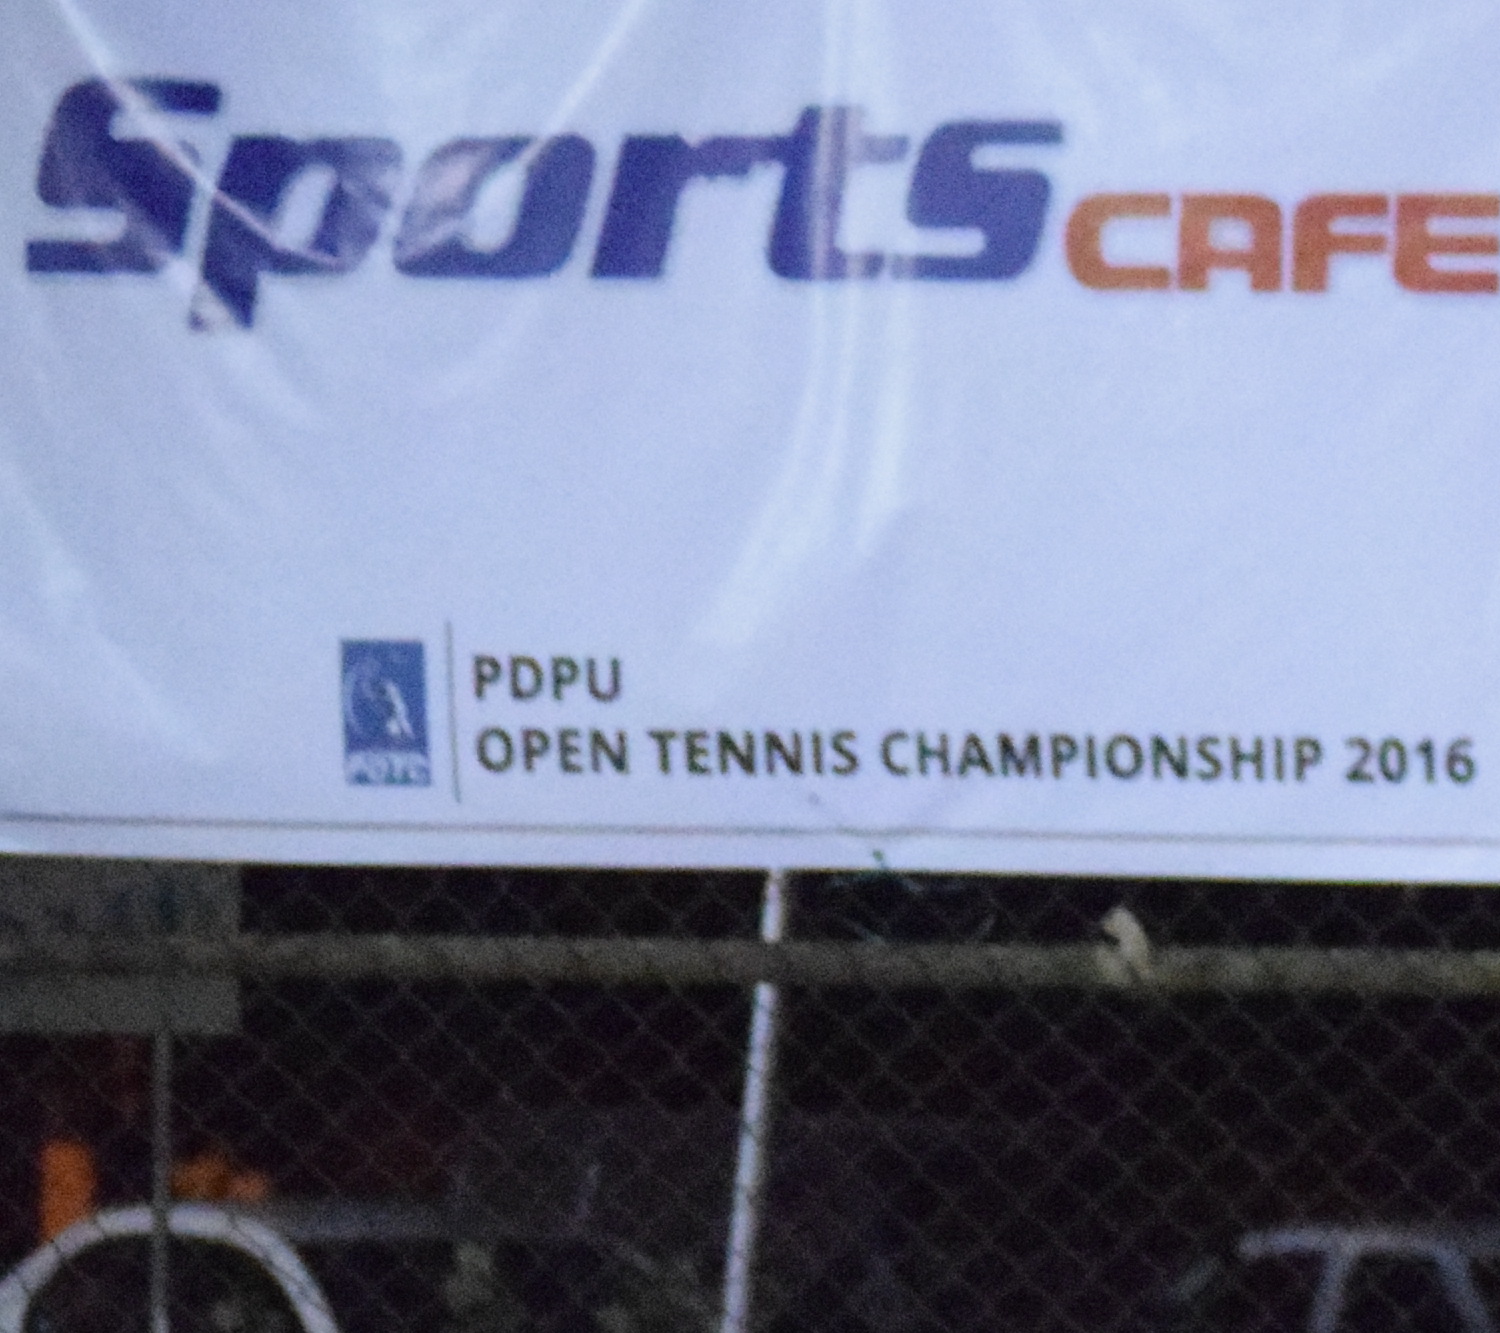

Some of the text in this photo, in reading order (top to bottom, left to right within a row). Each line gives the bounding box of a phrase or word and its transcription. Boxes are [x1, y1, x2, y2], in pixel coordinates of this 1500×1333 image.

[471, 652, 624, 706] PDPU
[473, 725, 631, 776] OPEN
[646, 727, 863, 779] TENNIS
[879, 729, 1325, 784] CHAMPIONSHIP
[1343, 735, 1479, 787] 2016
